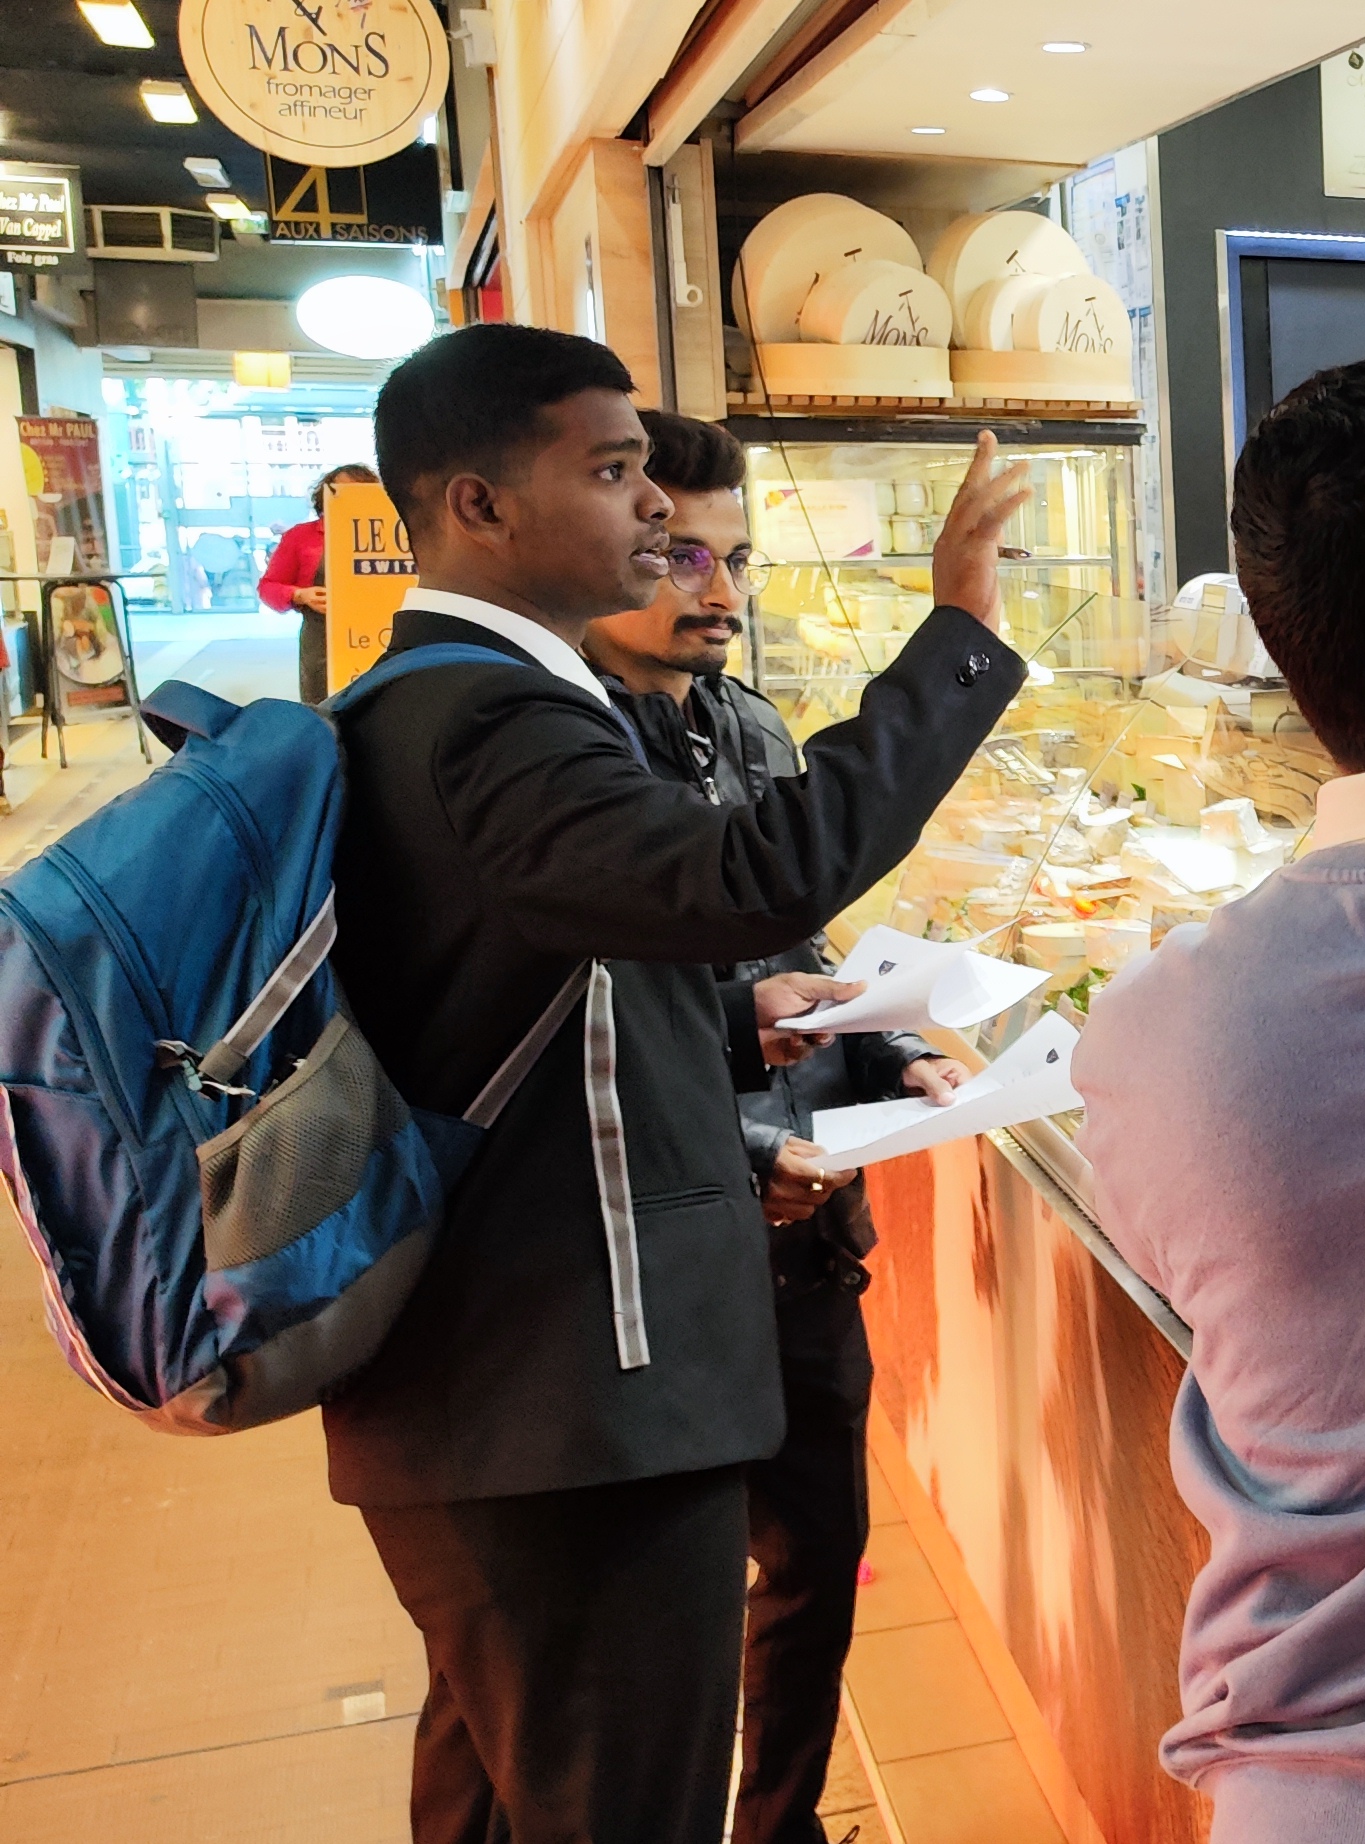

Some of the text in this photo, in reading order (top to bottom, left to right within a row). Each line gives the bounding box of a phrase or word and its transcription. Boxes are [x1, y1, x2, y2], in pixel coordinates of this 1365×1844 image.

[245, 23, 390, 79] MONS
[266, 78, 376, 105] fromager
[278, 100, 368, 121] affineur
[275, 222, 428, 243] AUX SAISONS
[66, 422, 96, 438] PAUL
[352, 518, 386, 553] LE
[348, 628, 371, 649] Le
